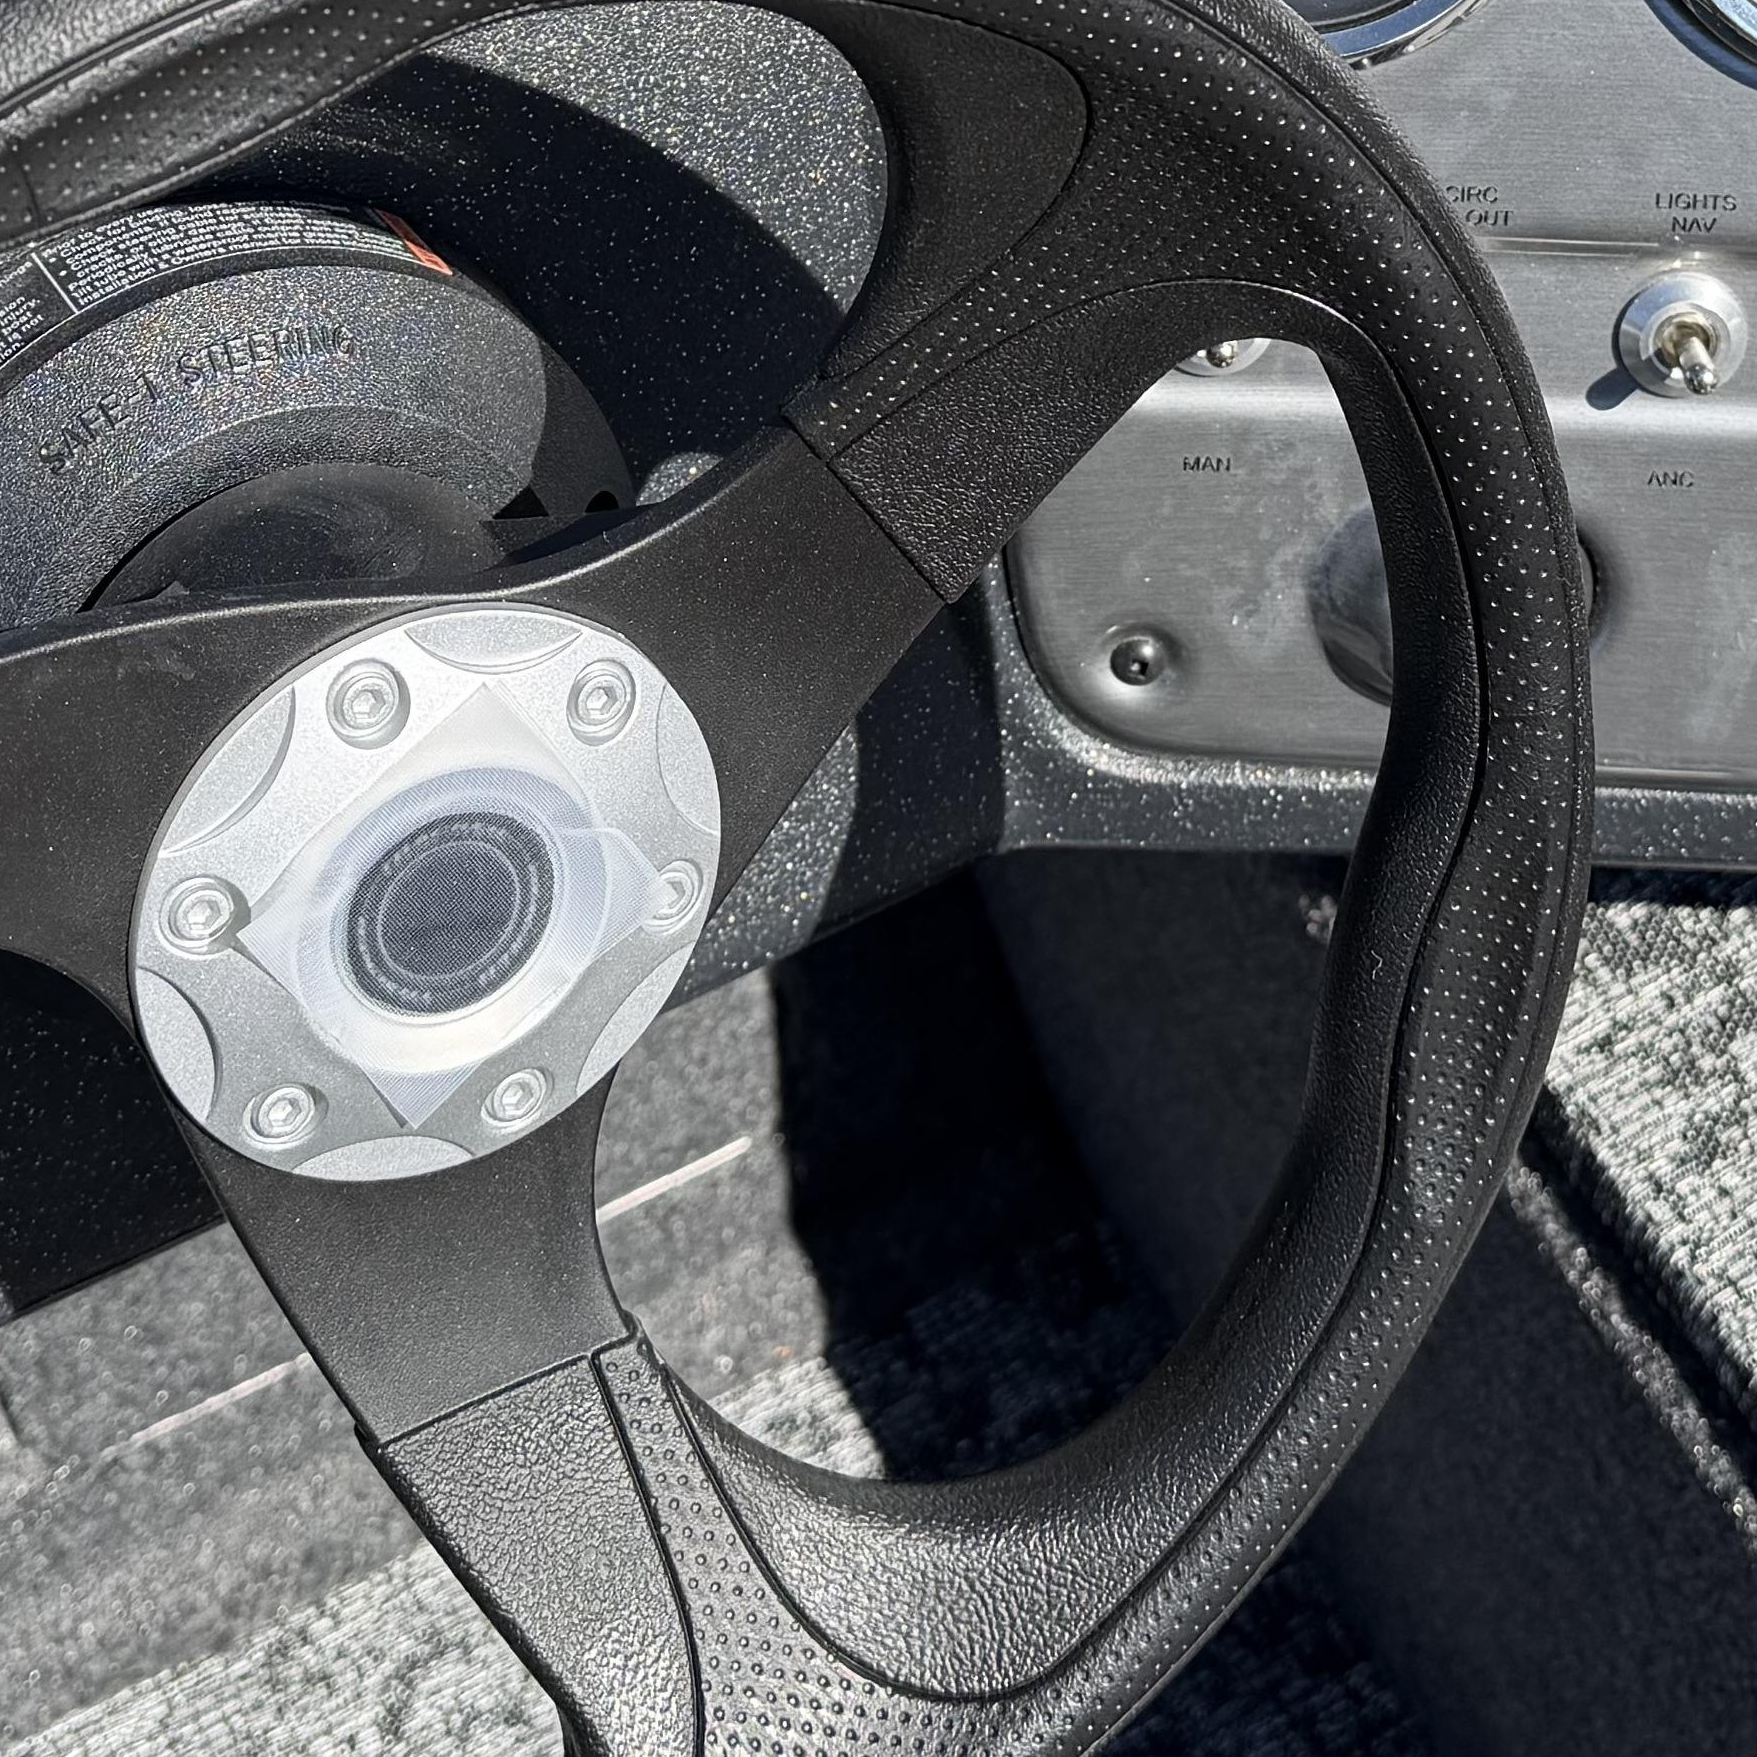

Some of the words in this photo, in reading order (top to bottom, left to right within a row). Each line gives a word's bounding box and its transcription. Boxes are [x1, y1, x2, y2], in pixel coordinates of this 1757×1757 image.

[1445, 186, 1498, 203] CIRC
[1655, 193, 1737, 211] LIGHTS
[1466, 209, 1513, 226] OUT
[1671, 217, 1717, 232] NAV
[59, 234, 105, 257] Check
[0, 310, 32, 336] boat
[20, 313, 44, 332] not
[176, 326, 354, 386] STEERING
[1183, 456, 1231, 472] MAN
[1647, 471, 1694, 488] ANC
